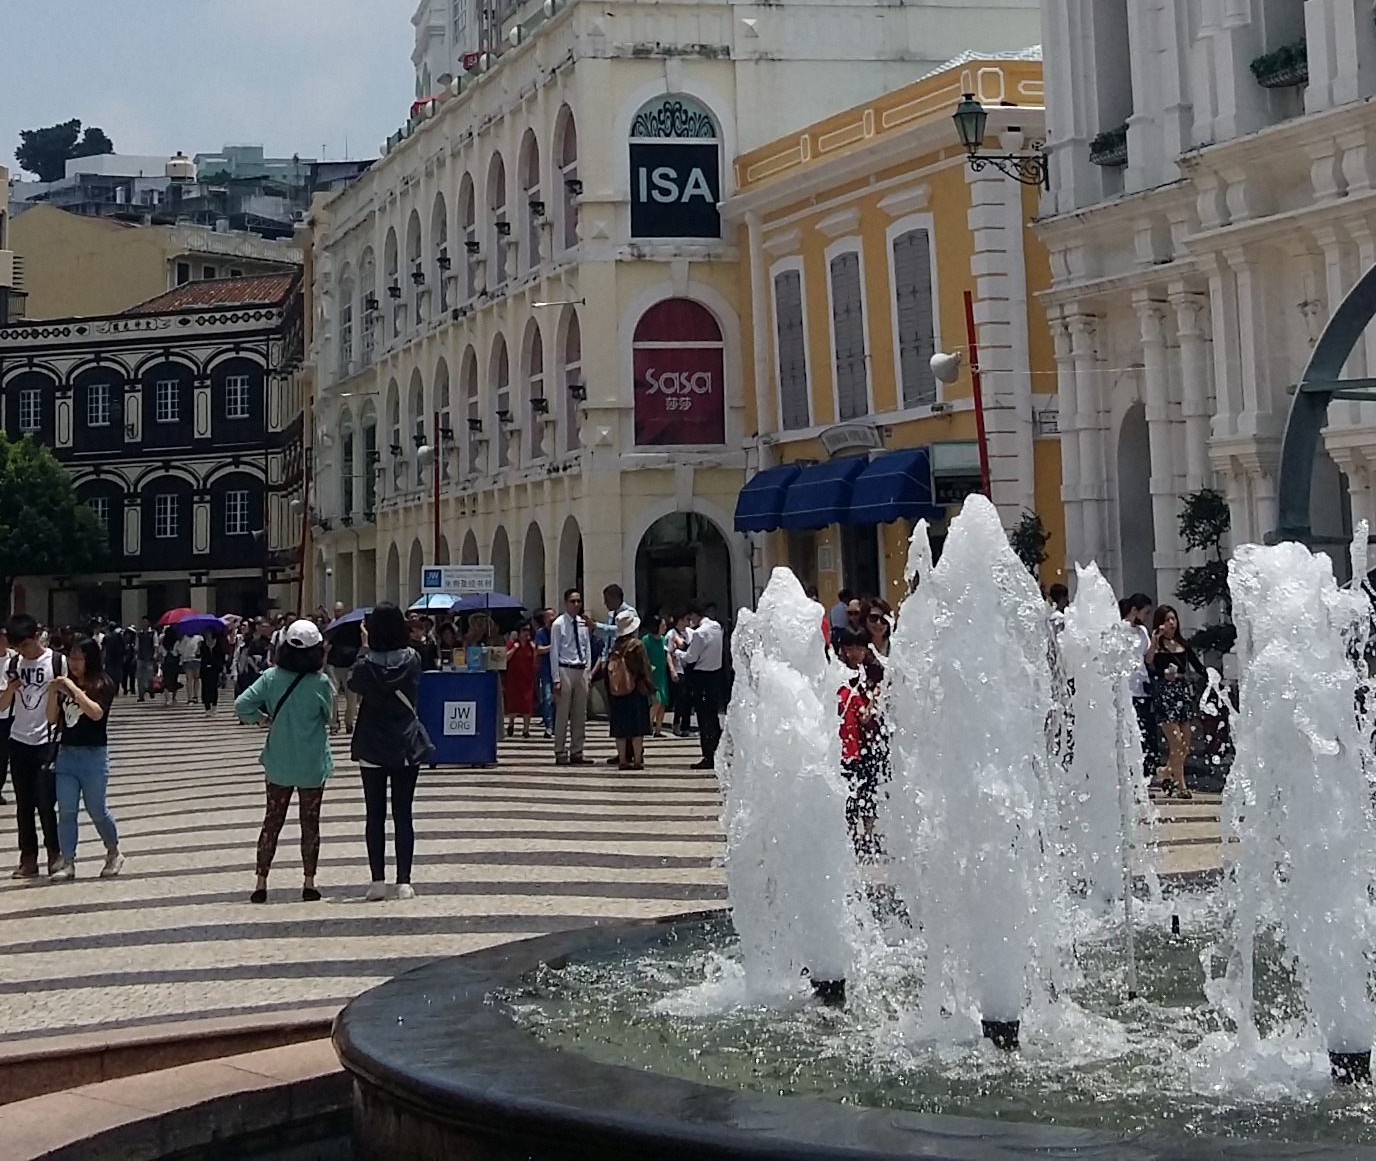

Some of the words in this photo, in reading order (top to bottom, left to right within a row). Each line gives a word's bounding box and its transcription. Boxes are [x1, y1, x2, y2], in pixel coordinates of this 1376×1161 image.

[638, 166, 715, 204] ISA
[426, 571, 440, 580] JW
[450, 707, 471, 720] JW
[449, 721, 471, 730] ORG
